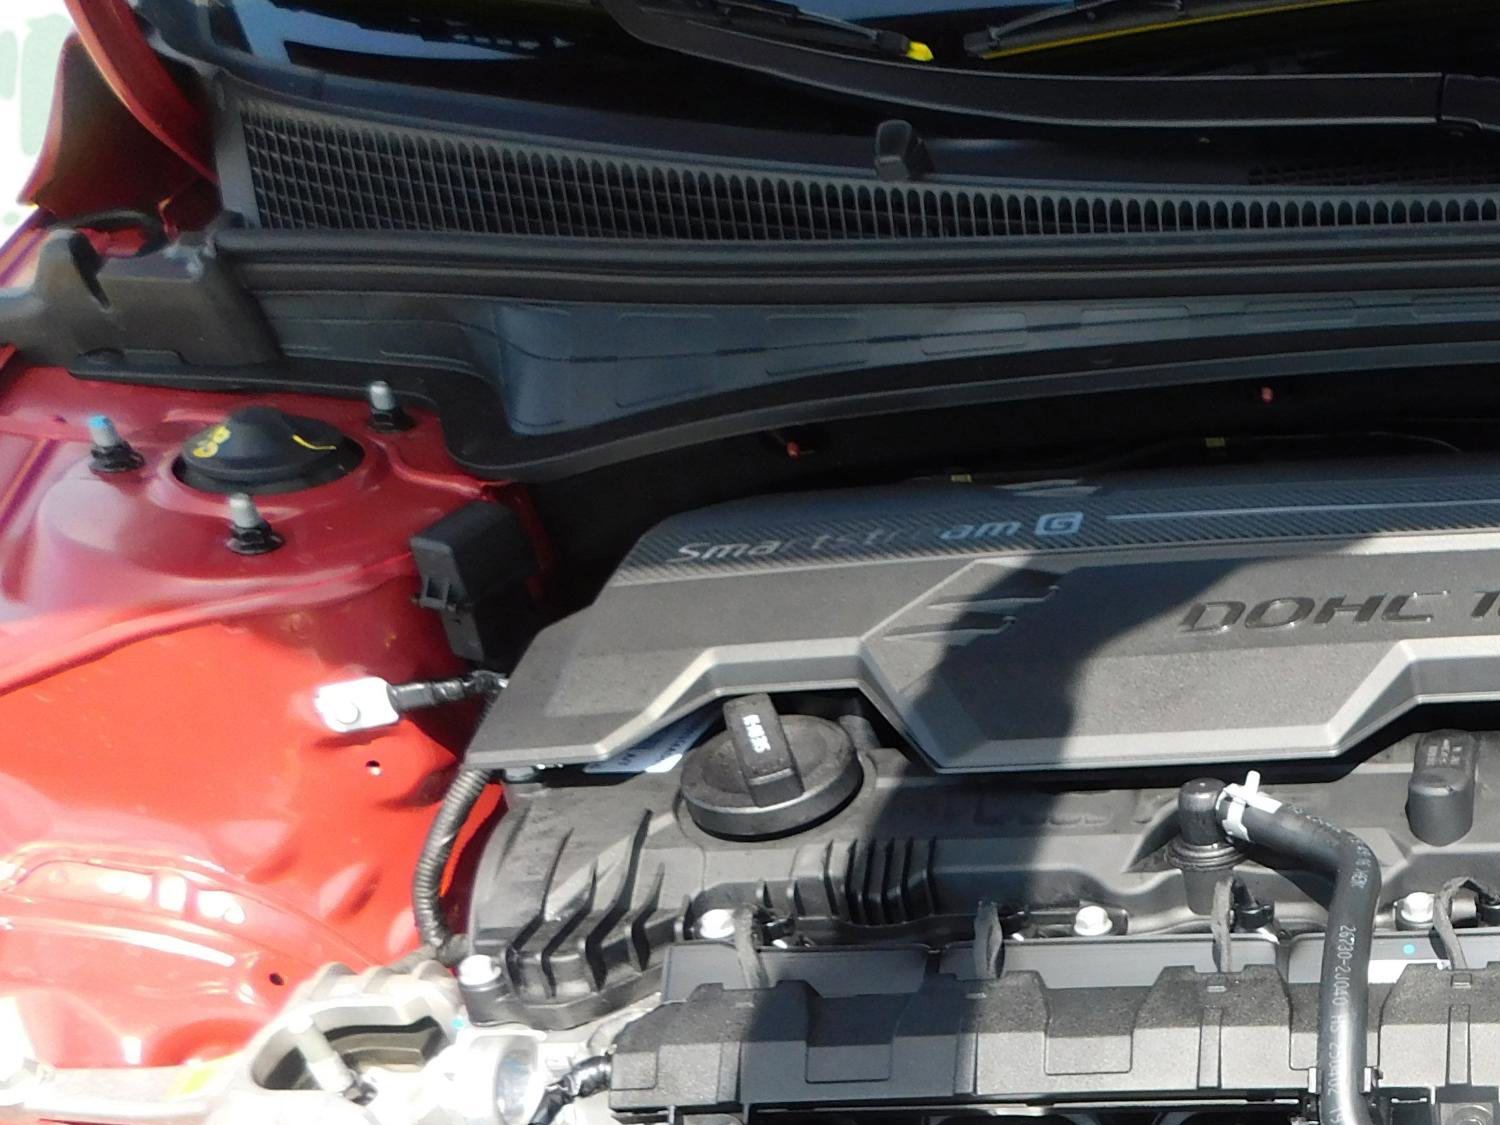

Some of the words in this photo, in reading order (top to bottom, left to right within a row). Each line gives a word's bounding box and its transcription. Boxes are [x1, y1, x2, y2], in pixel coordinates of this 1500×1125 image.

[666, 519, 1020, 563] Smartstram
[1176, 590, 1450, 635] DOHC
[1332, 924, 1357, 1006] 26730-2J040
